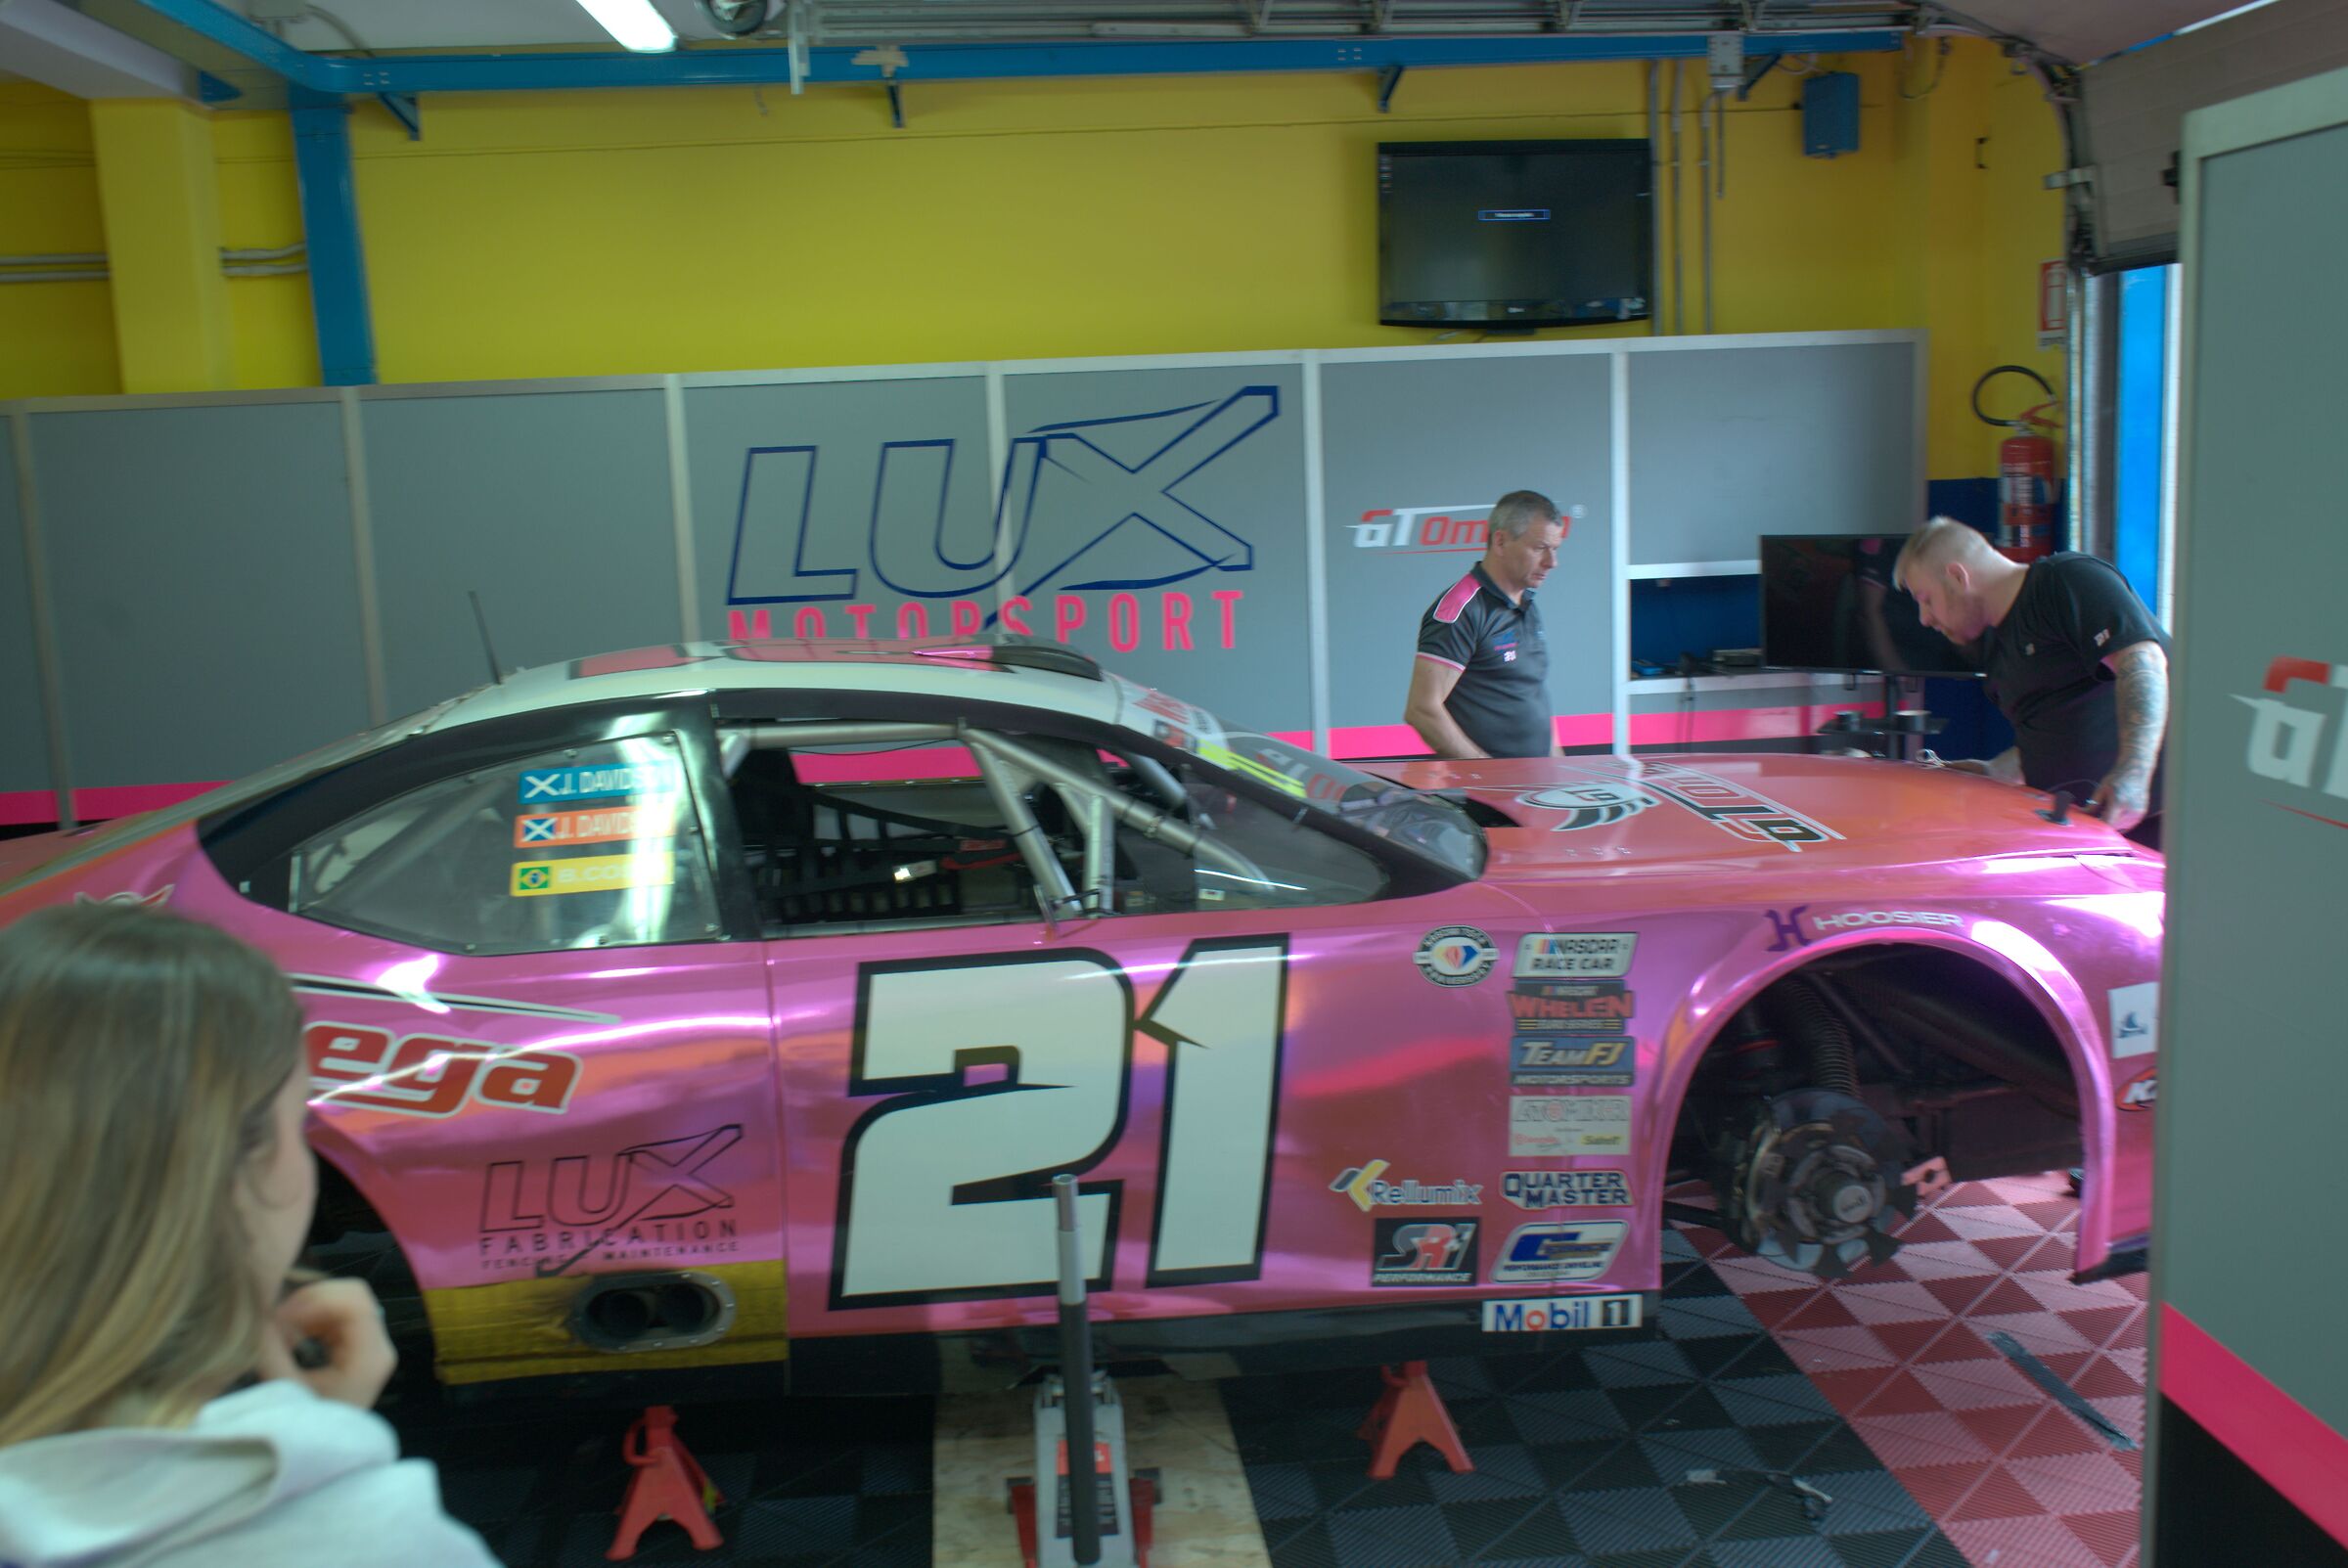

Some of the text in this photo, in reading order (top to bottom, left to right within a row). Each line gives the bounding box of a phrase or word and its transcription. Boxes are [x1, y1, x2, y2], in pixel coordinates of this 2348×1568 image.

[727, 385, 1279, 616] LUX
[1812, 910, 1966, 930] HOOSIER
[1579, 958, 1614, 971] CAR
[1507, 991, 1634, 1018] WHELEN
[304, 1020, 583, 1118] ega
[828, 933, 1291, 1311] 21
[479, 1124, 744, 1238] LUX
[1503, 1172, 1622, 1198] QUARTER
[1525, 1188, 1629, 1209] MASTER
[479, 1220, 738, 1256] FABRICATION
[1495, 1301, 1625, 1330] Mobil 1
